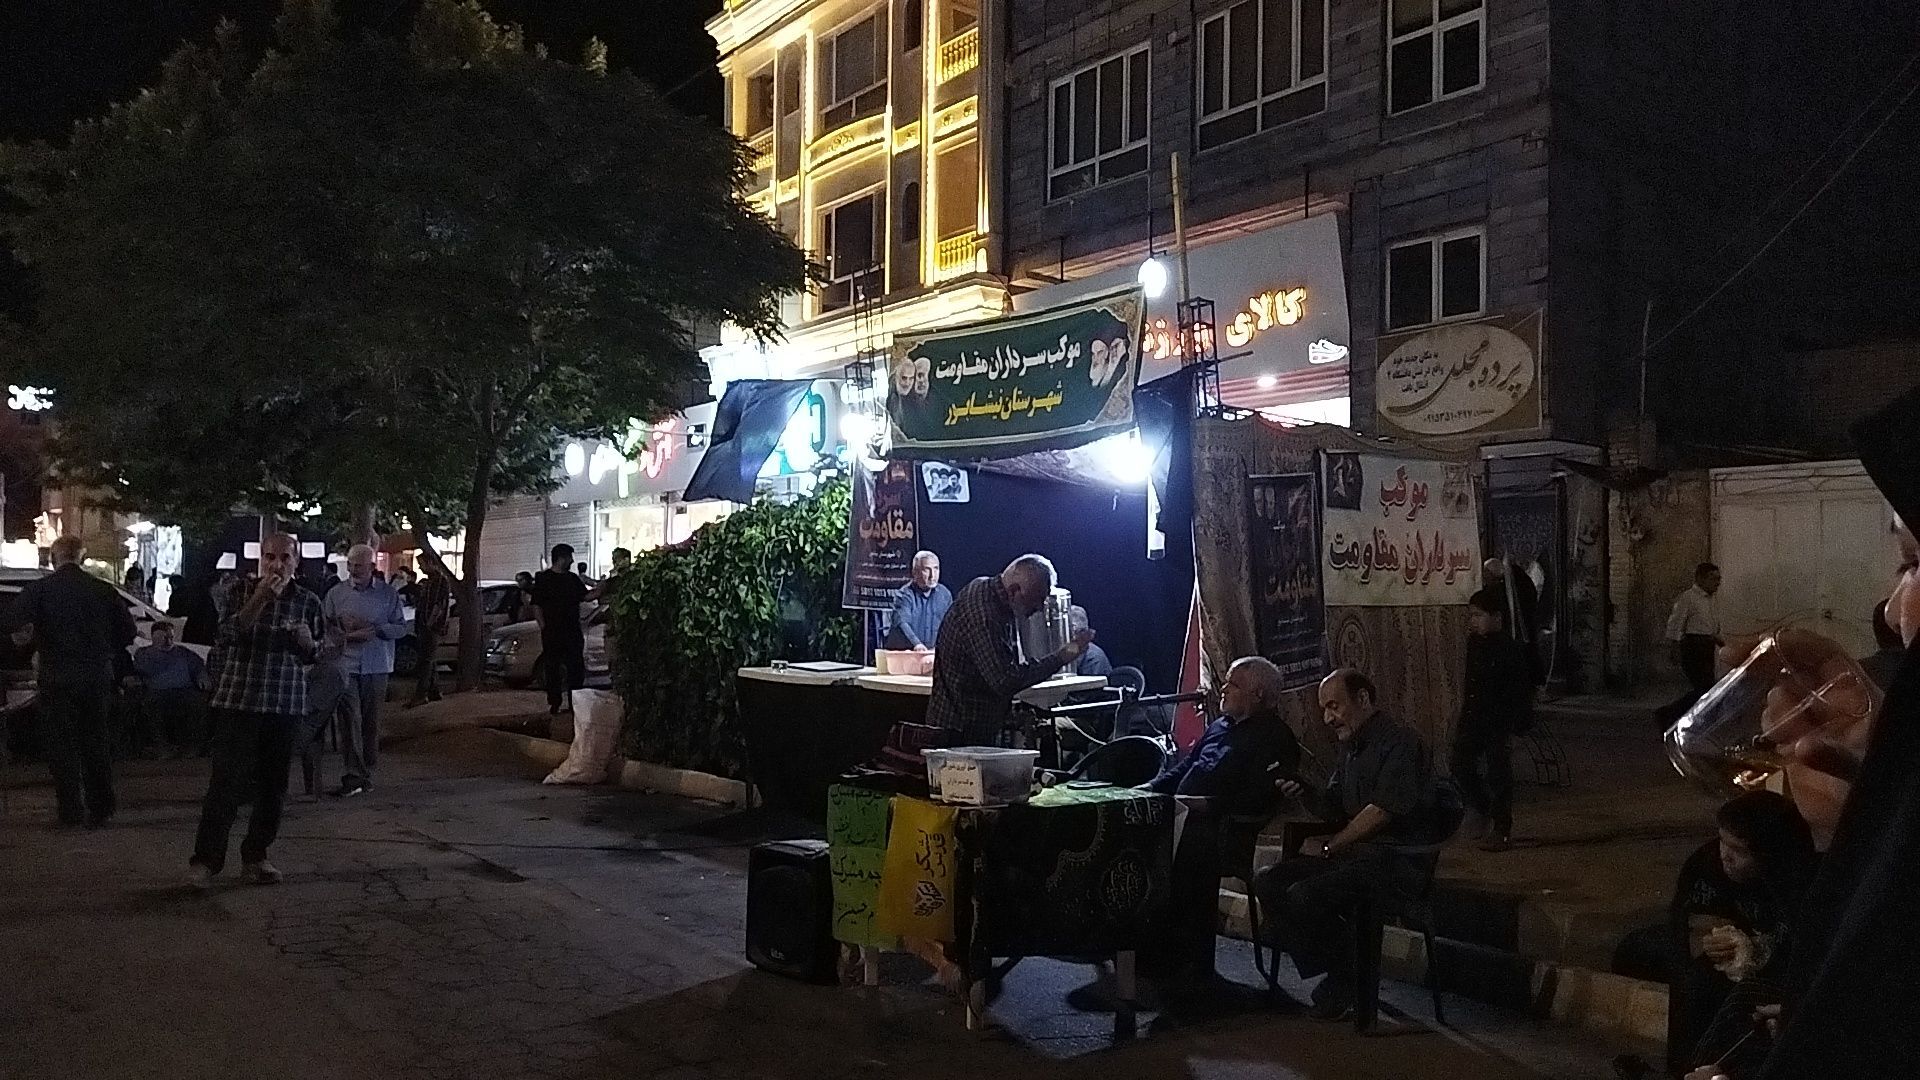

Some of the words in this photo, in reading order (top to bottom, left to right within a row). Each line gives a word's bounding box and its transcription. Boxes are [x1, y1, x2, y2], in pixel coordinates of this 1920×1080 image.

[1225, 286, 1307, 347] کالای
[935, 352, 989, 386] مقاومت
[989, 344, 1047, 382] سرداران
[1047, 334, 1081, 369] موکب
[944, 388, 1003, 426] نیشابور
[1001, 381, 1063, 420] شهرستان
[1378, 464, 1429, 521] موکب
[859, 508, 914, 548] مقاومت
[1328, 526, 1401, 584] مقاومت
[1403, 529, 1472, 586] سرداران
